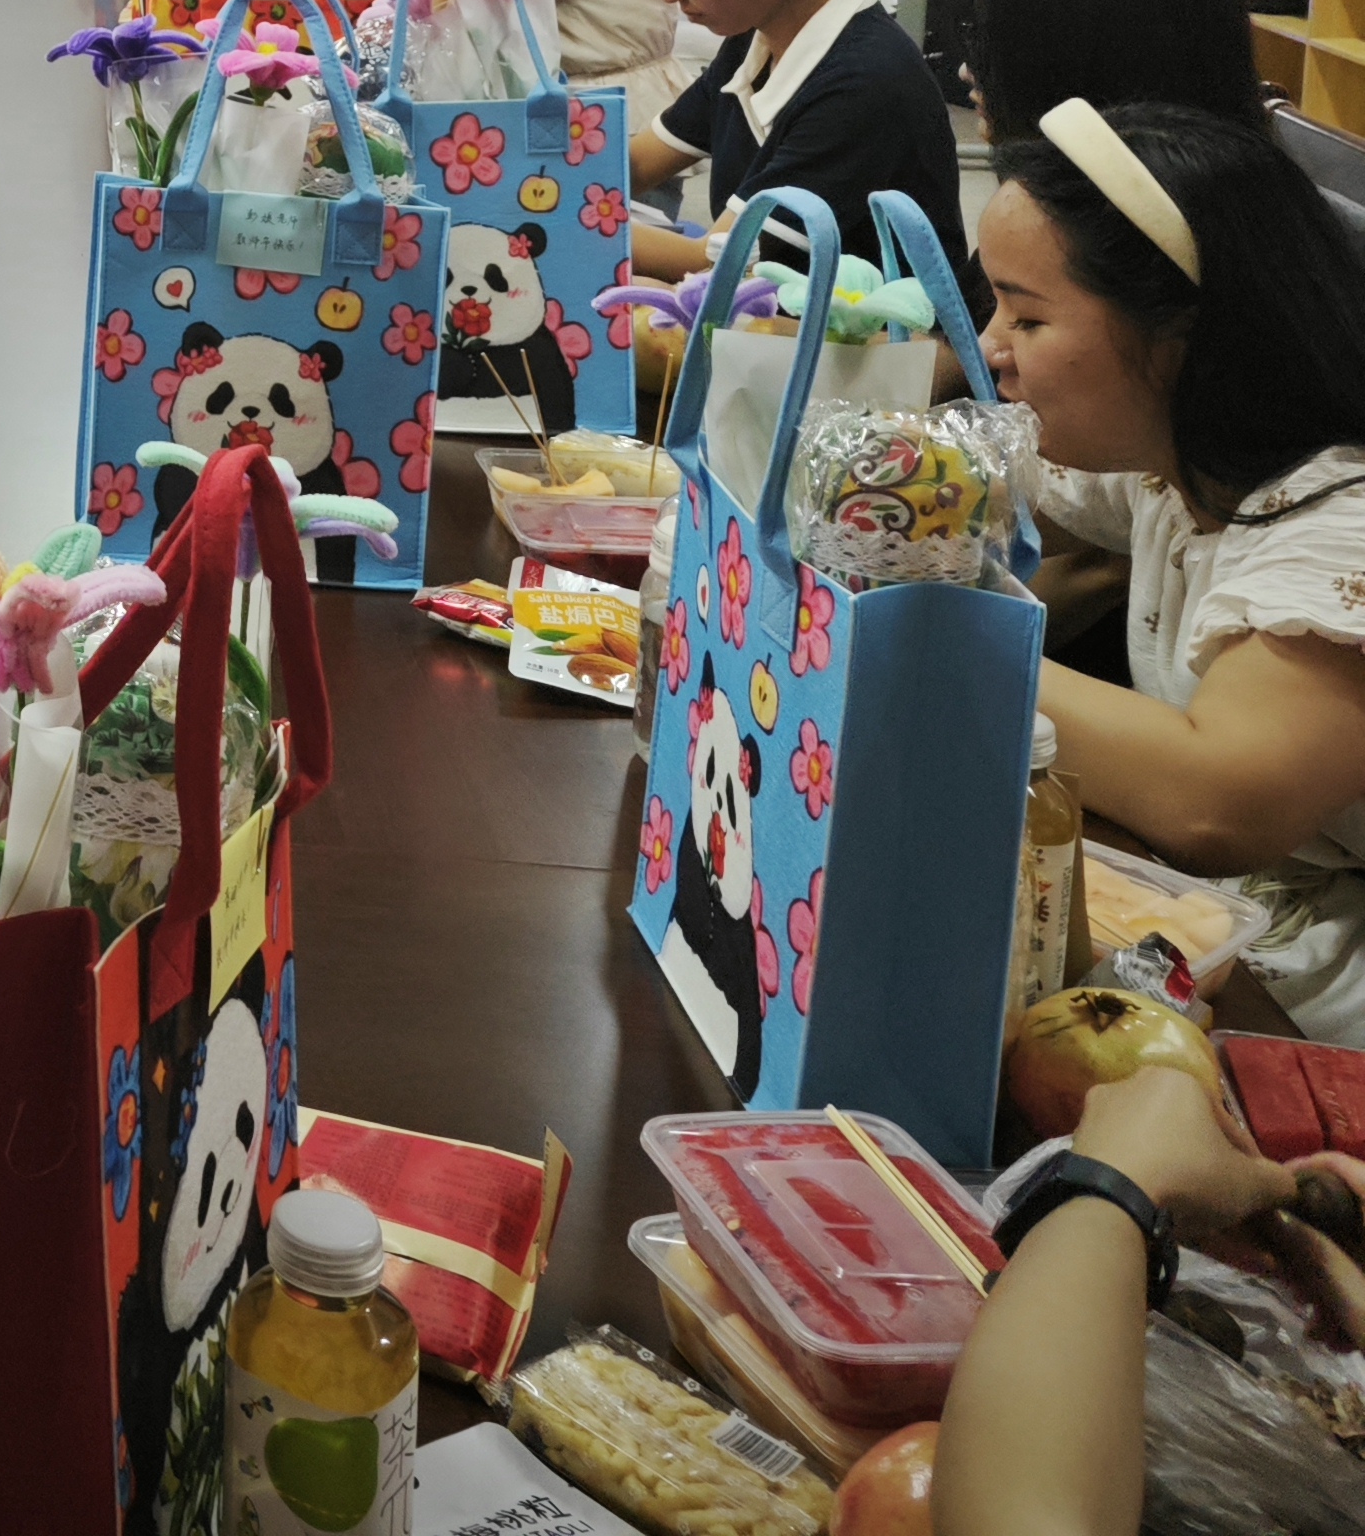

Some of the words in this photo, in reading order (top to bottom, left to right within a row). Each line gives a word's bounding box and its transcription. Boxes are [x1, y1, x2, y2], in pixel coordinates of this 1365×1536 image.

[527, 593, 553, 604] Salt
[553, 593, 592, 605] Baked
[593, 596, 630, 613] Padan
